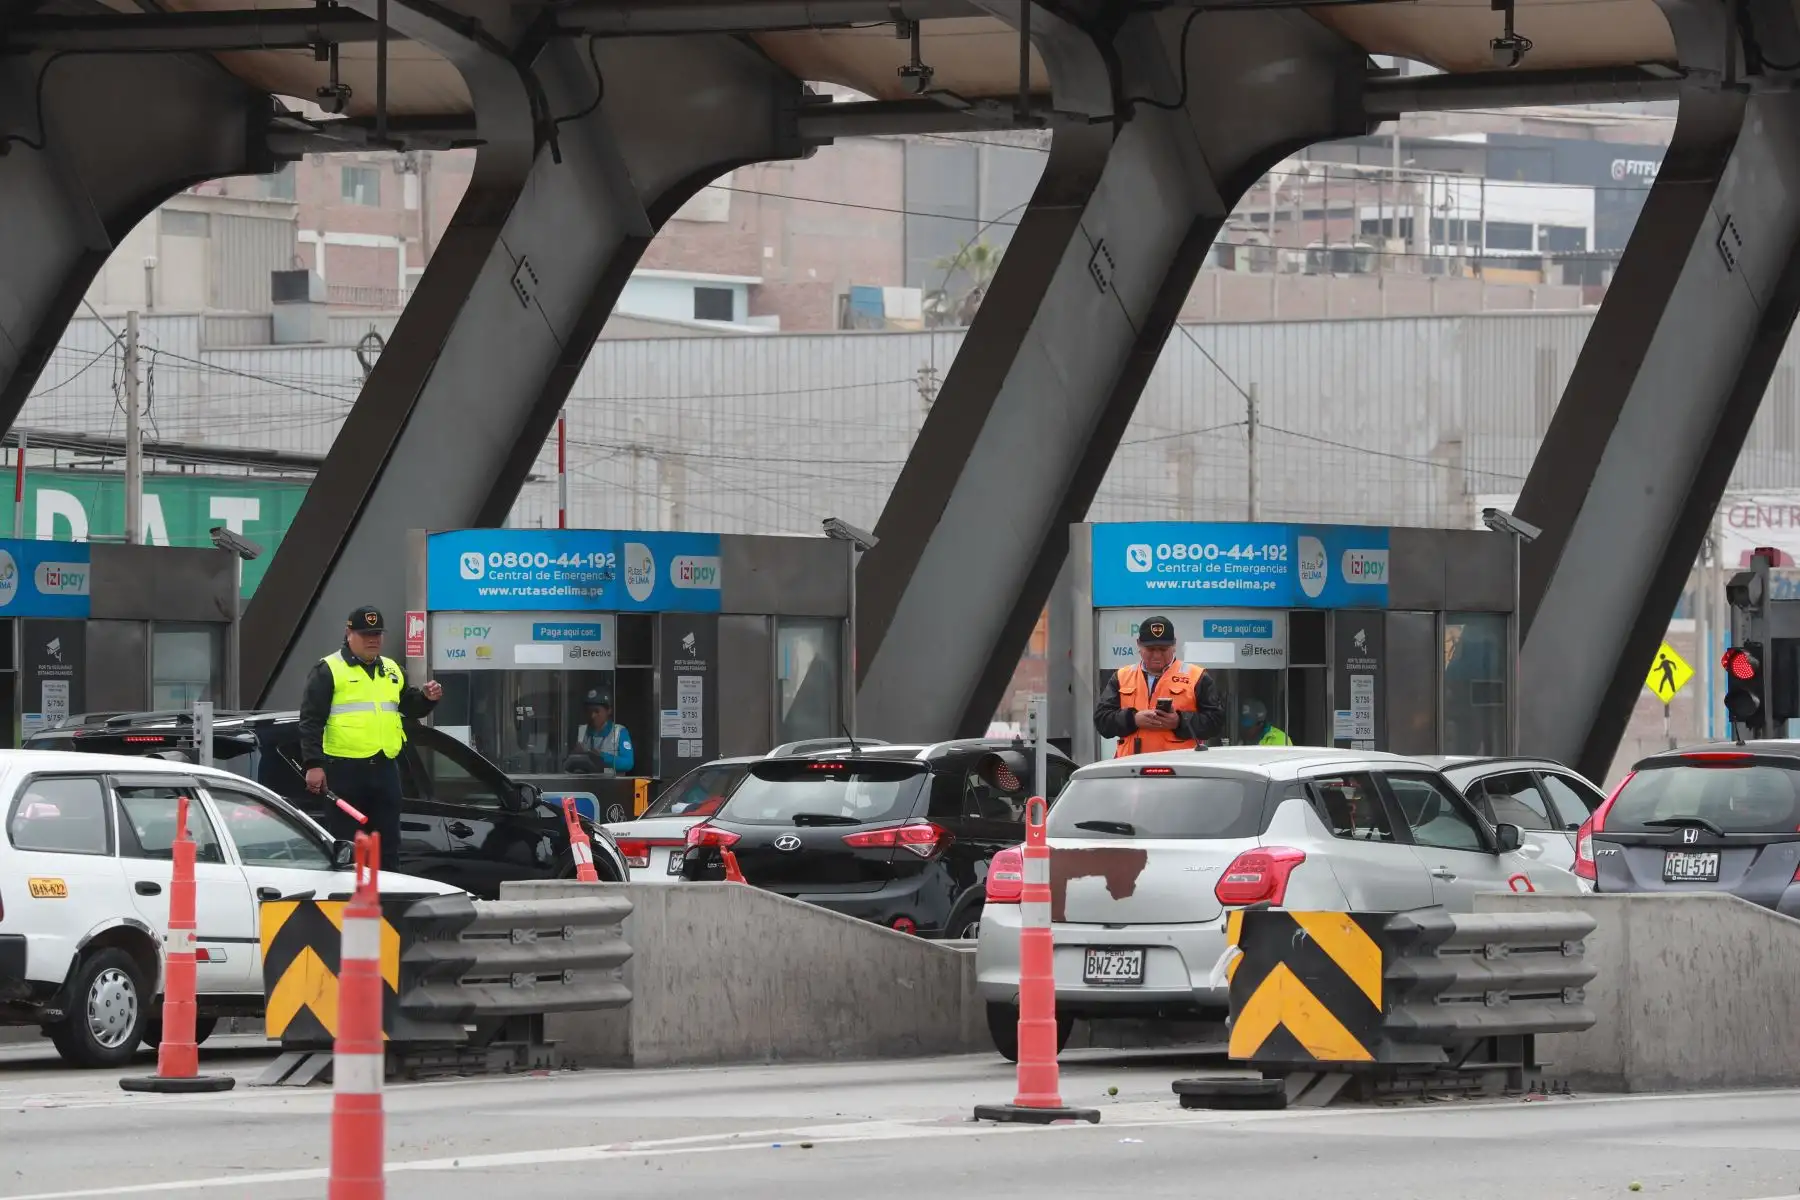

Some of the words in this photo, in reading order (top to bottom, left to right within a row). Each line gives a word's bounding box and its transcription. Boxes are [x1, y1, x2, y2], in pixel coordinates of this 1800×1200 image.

[1157, 543, 1288, 561] 0800-44-192
[488, 552, 616, 568] 0800-44-192
[680, 560, 716, 584] izipay
[1157, 563, 1202, 573] Central
[1205, 563, 1221, 573] de
[1224, 563, 1288, 575] Emergencias
[1351, 554, 1384, 580] izipay
[47, 567, 85, 591] izipay
[488, 571, 532, 580] Central
[539, 571, 551, 580] de
[554, 571, 616, 582] Emergencias
[1146, 578, 1276, 591] www.rutasdelima.pe
[478, 585, 604, 597] www.rutasdelima.pe
[540, 627, 561, 638] Paga
[1211, 623, 1233, 635] Paga
[446, 649, 467, 658] VISA
[582, 649, 611, 657] Efectivo
[1113, 646, 1134, 656] VISA
[1254, 647, 1283, 656] Efectivo
[1665, 859, 1716, 876] AEU-511
[1088, 956, 1139, 975] BWZ-231
